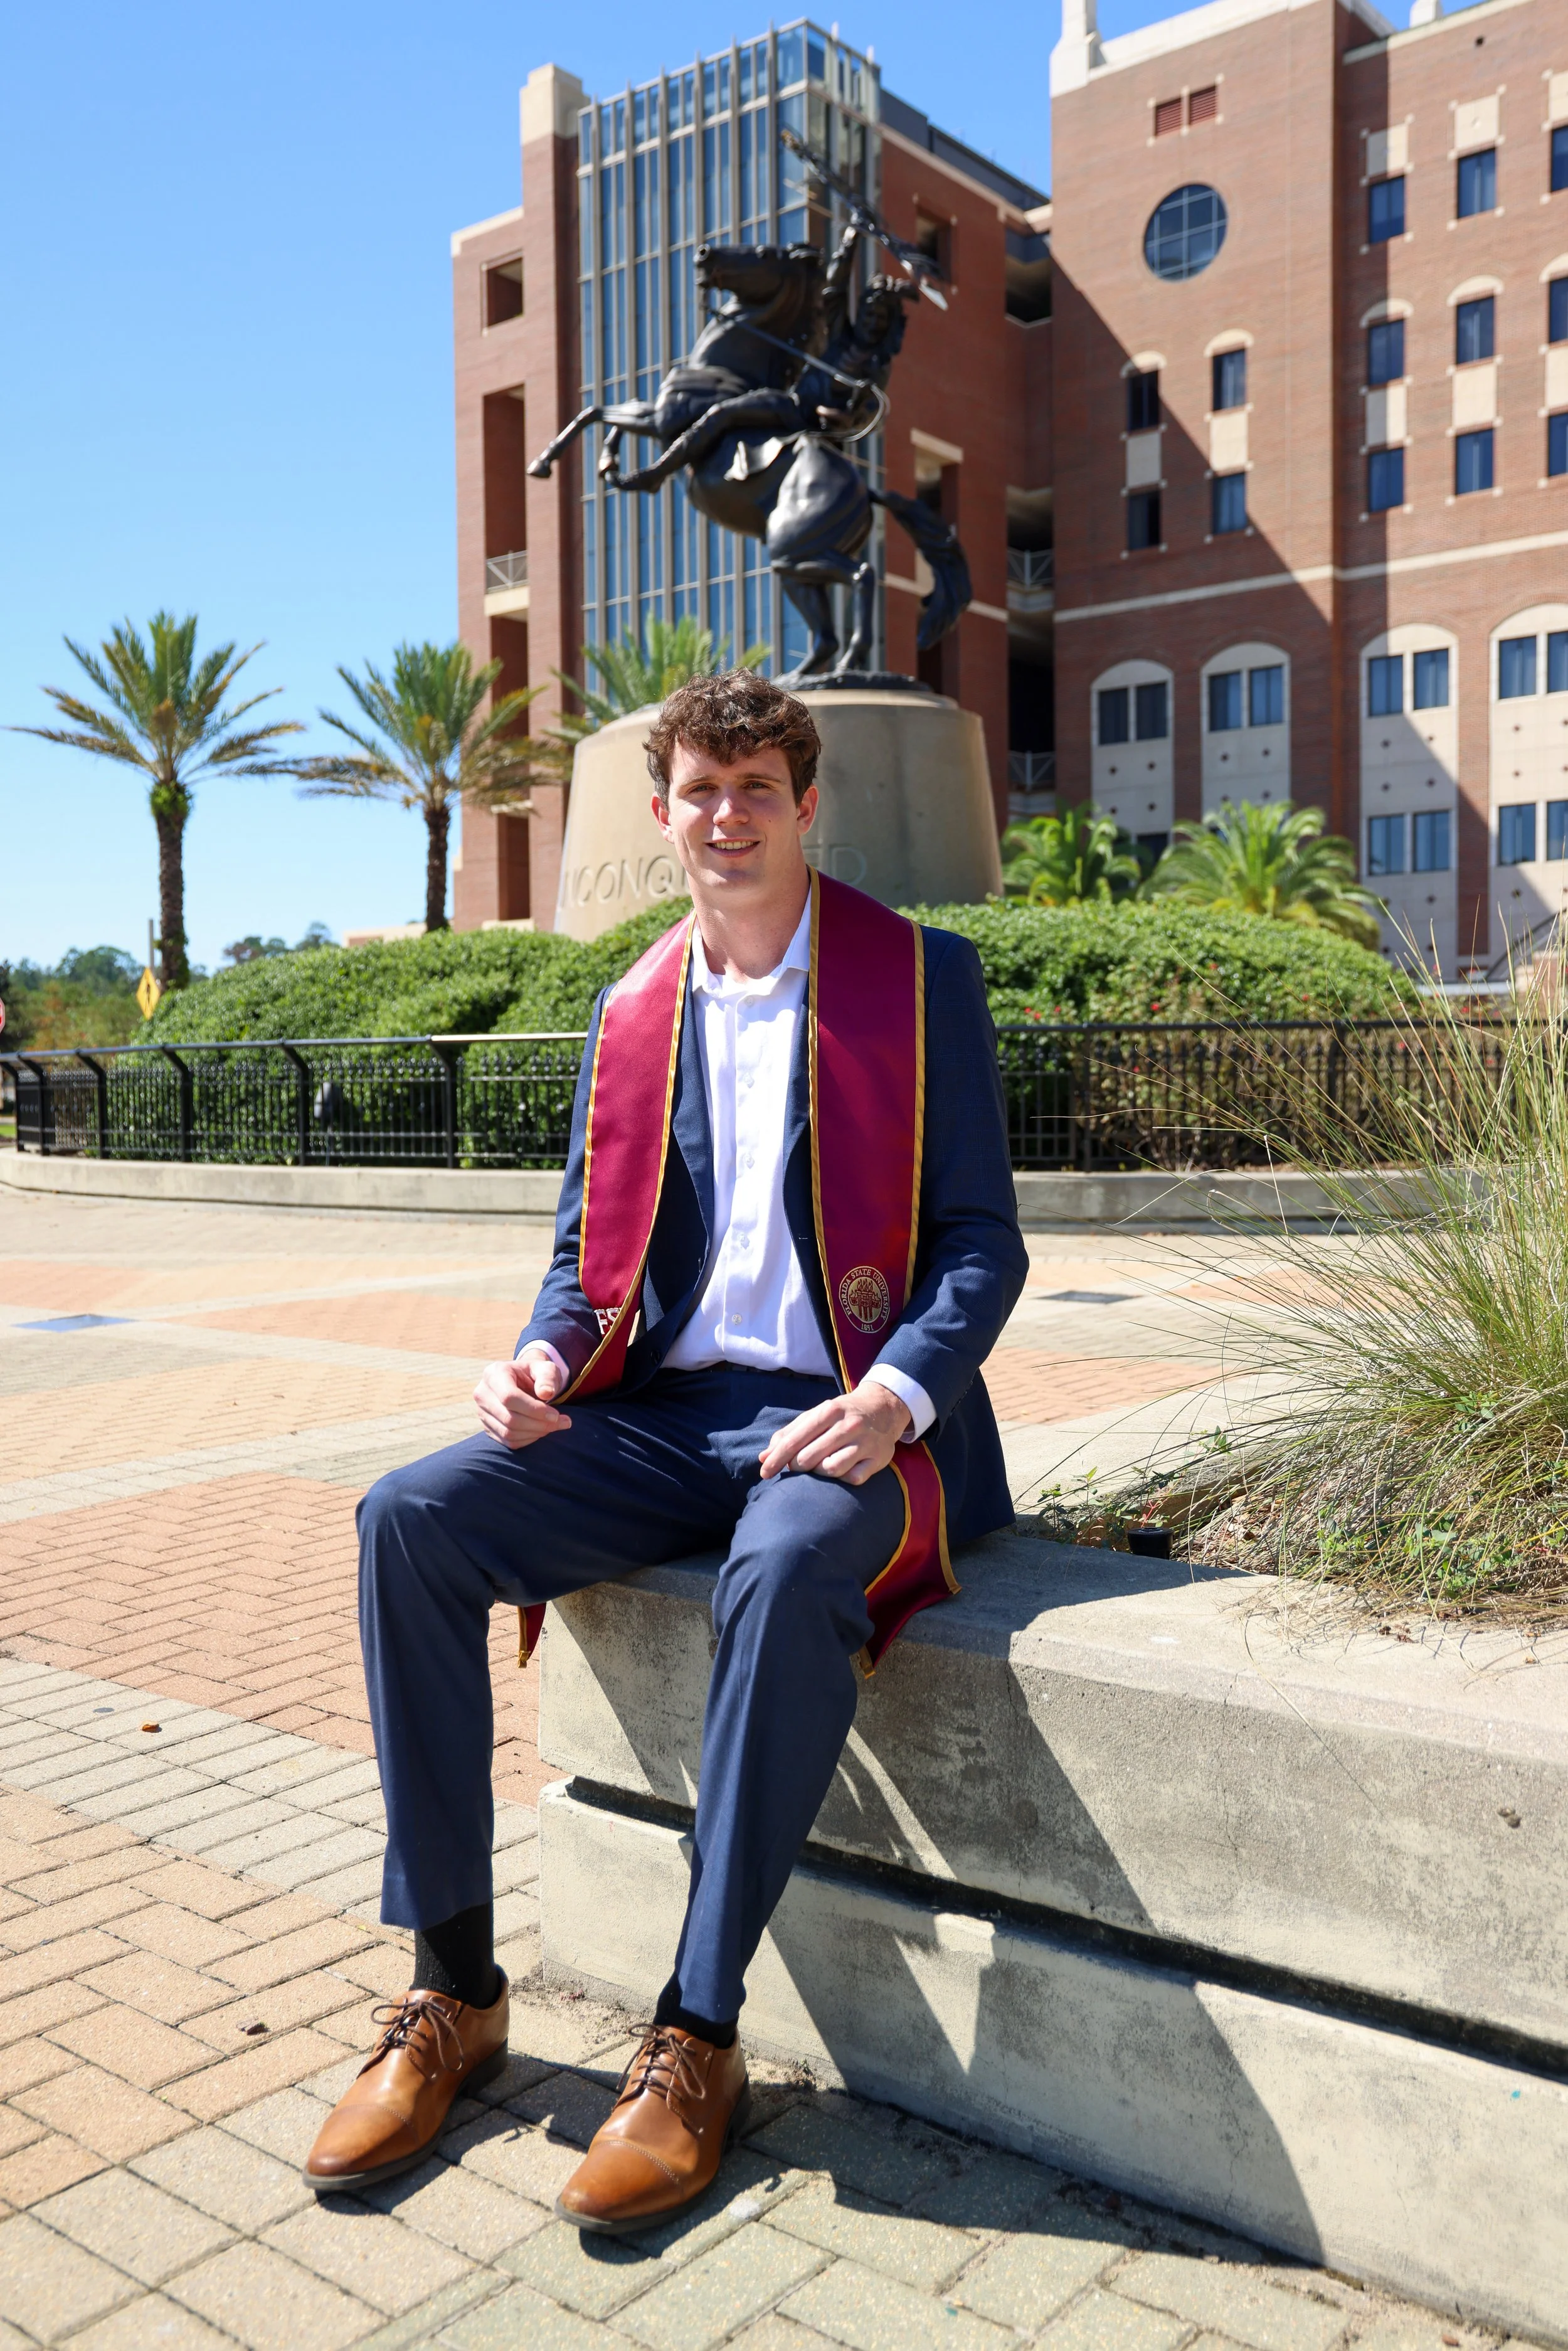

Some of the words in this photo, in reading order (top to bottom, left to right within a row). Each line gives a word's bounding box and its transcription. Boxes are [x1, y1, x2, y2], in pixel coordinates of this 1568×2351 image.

[841, 1278, 852, 1316] FLORIDA
[851, 1268, 871, 1279] STATE
[872, 1272, 888, 1320] UNIVERSITY
[593, 1307, 622, 1335] FS
